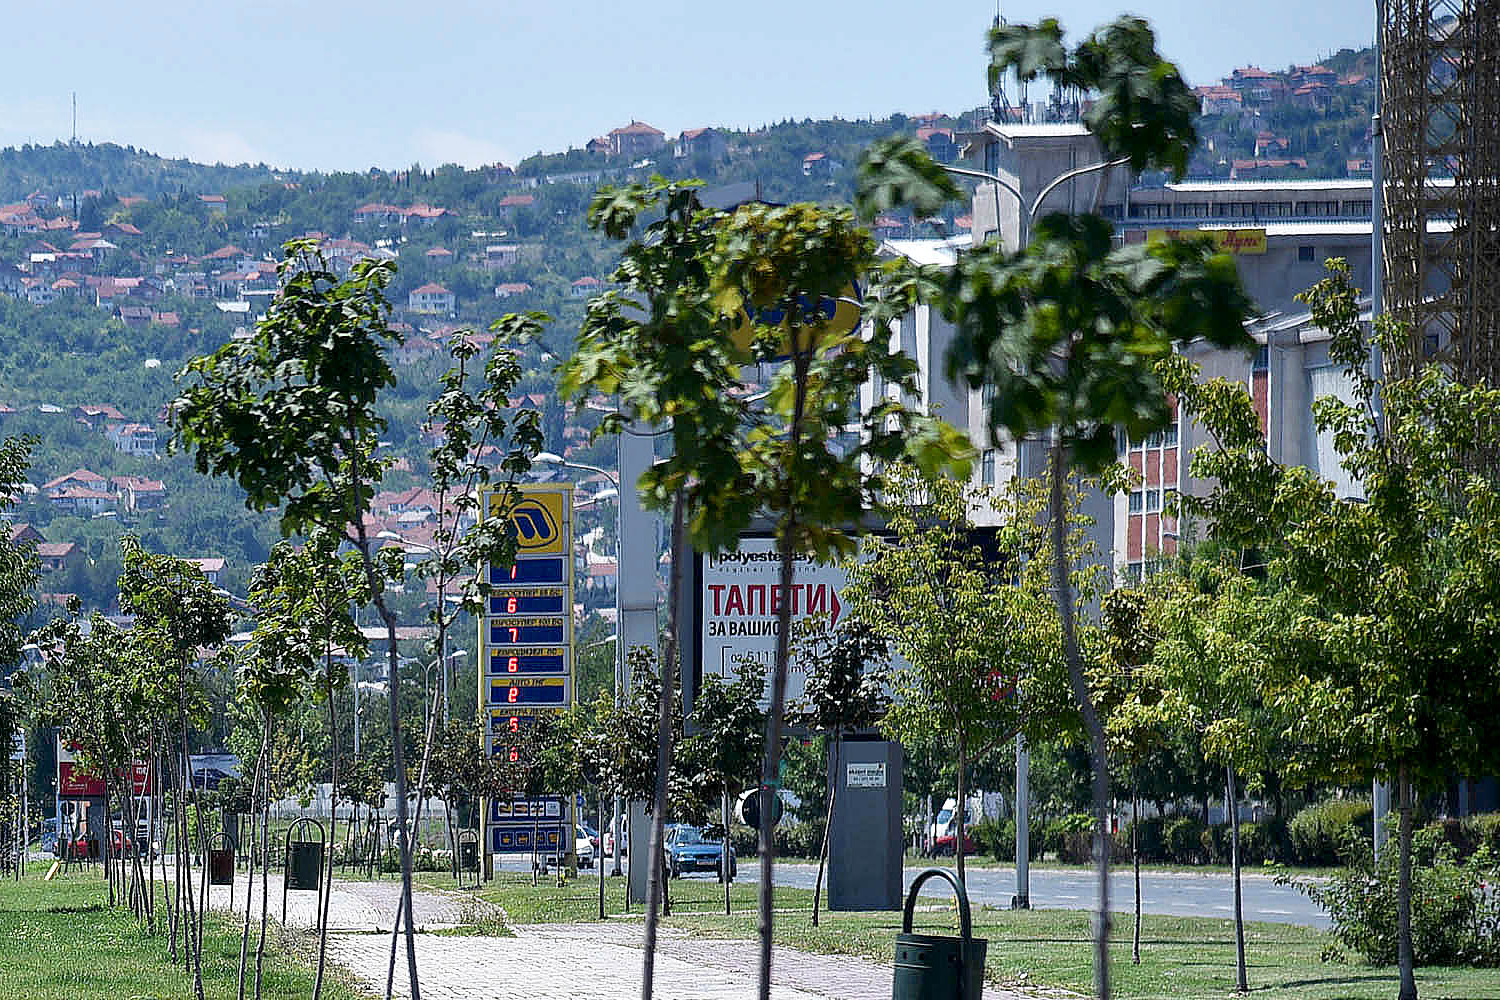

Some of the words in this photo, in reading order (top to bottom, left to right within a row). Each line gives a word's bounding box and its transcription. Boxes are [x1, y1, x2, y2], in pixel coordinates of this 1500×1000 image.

[719, 550, 816, 565] polyesteday
[707, 583, 826, 617] ТАПЕТИ
[708, 621, 726, 637] ЗА
[729, 621, 786, 637] ВАШИО
